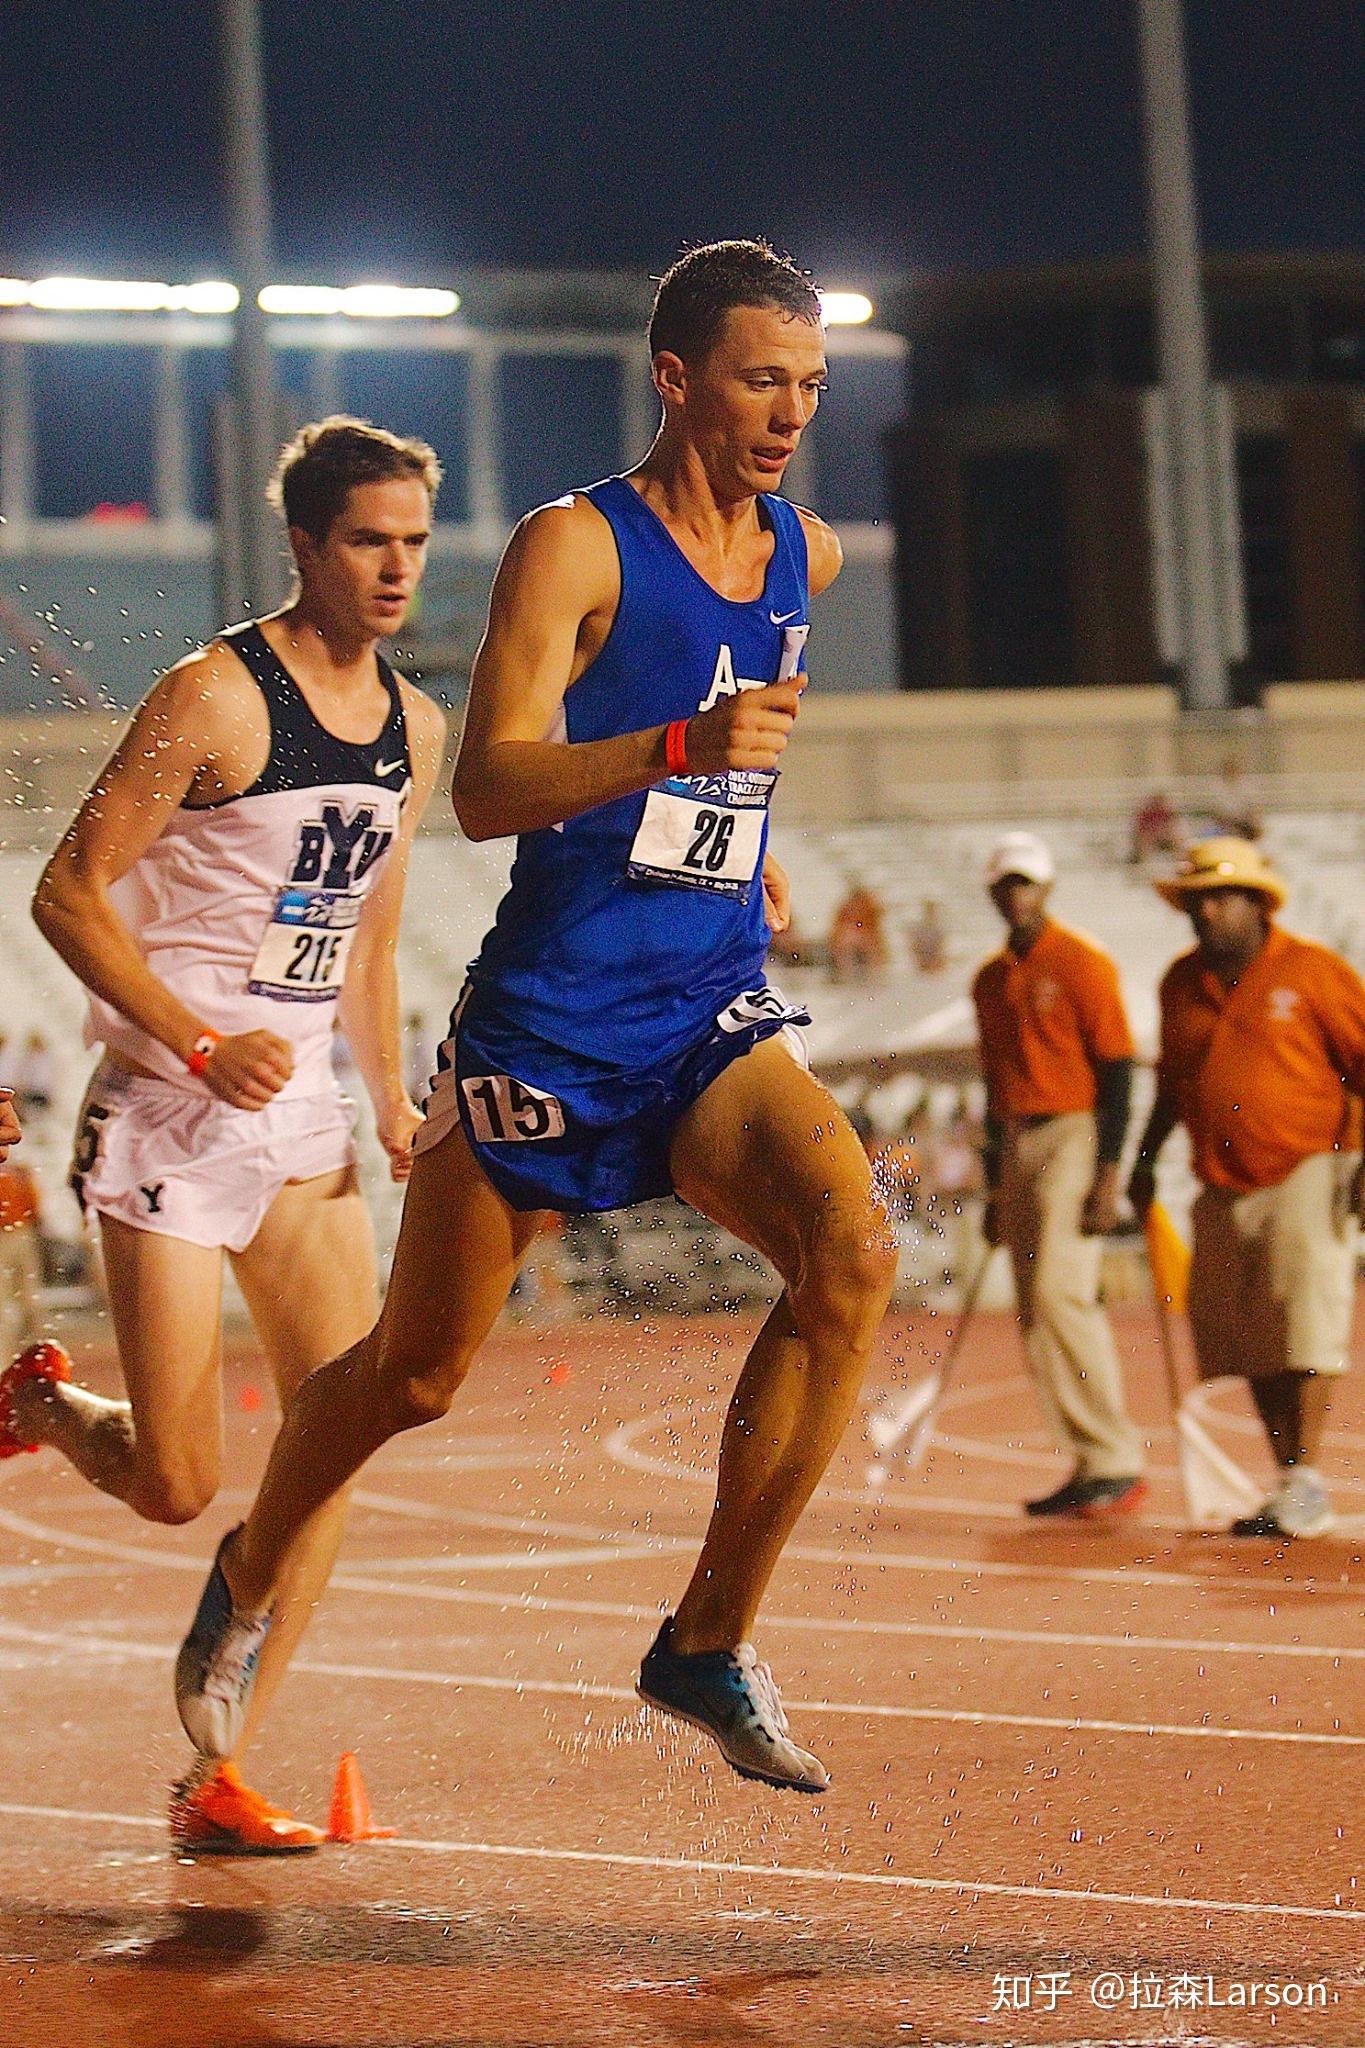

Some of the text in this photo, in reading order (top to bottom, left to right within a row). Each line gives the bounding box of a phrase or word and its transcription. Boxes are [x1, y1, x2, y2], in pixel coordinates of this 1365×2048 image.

[289, 803, 393, 890] BYU
[682, 809, 735, 872] 26
[284, 932, 342, 982] 215
[472, 1077, 550, 1139] 15
[139, 1181, 166, 1213] Y
